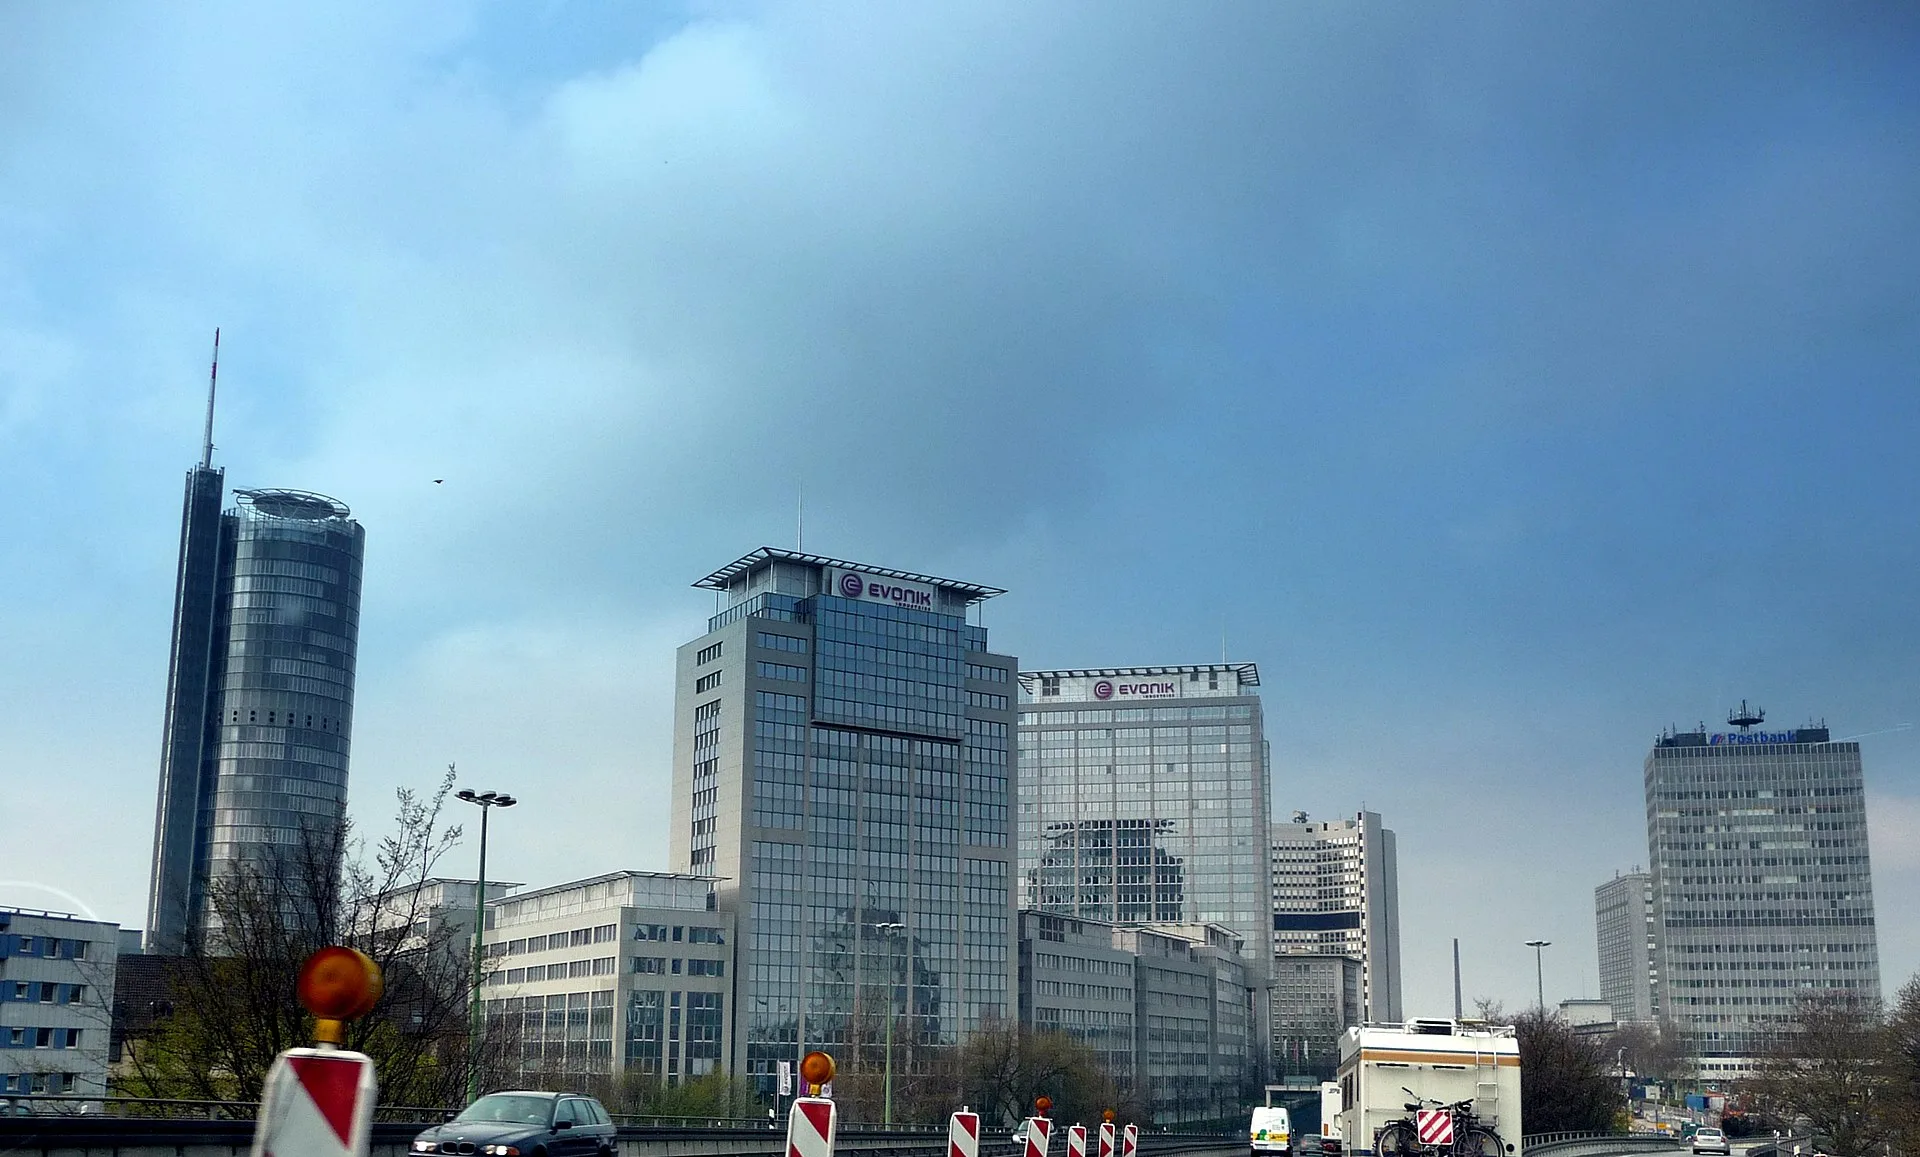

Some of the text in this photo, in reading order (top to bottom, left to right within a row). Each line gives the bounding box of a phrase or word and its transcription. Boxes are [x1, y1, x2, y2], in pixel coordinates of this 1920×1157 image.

[869, 583, 931, 606] EVONIK
[1119, 683, 1175, 694] EVONIK
[1728, 730, 1797, 743] Postbank
